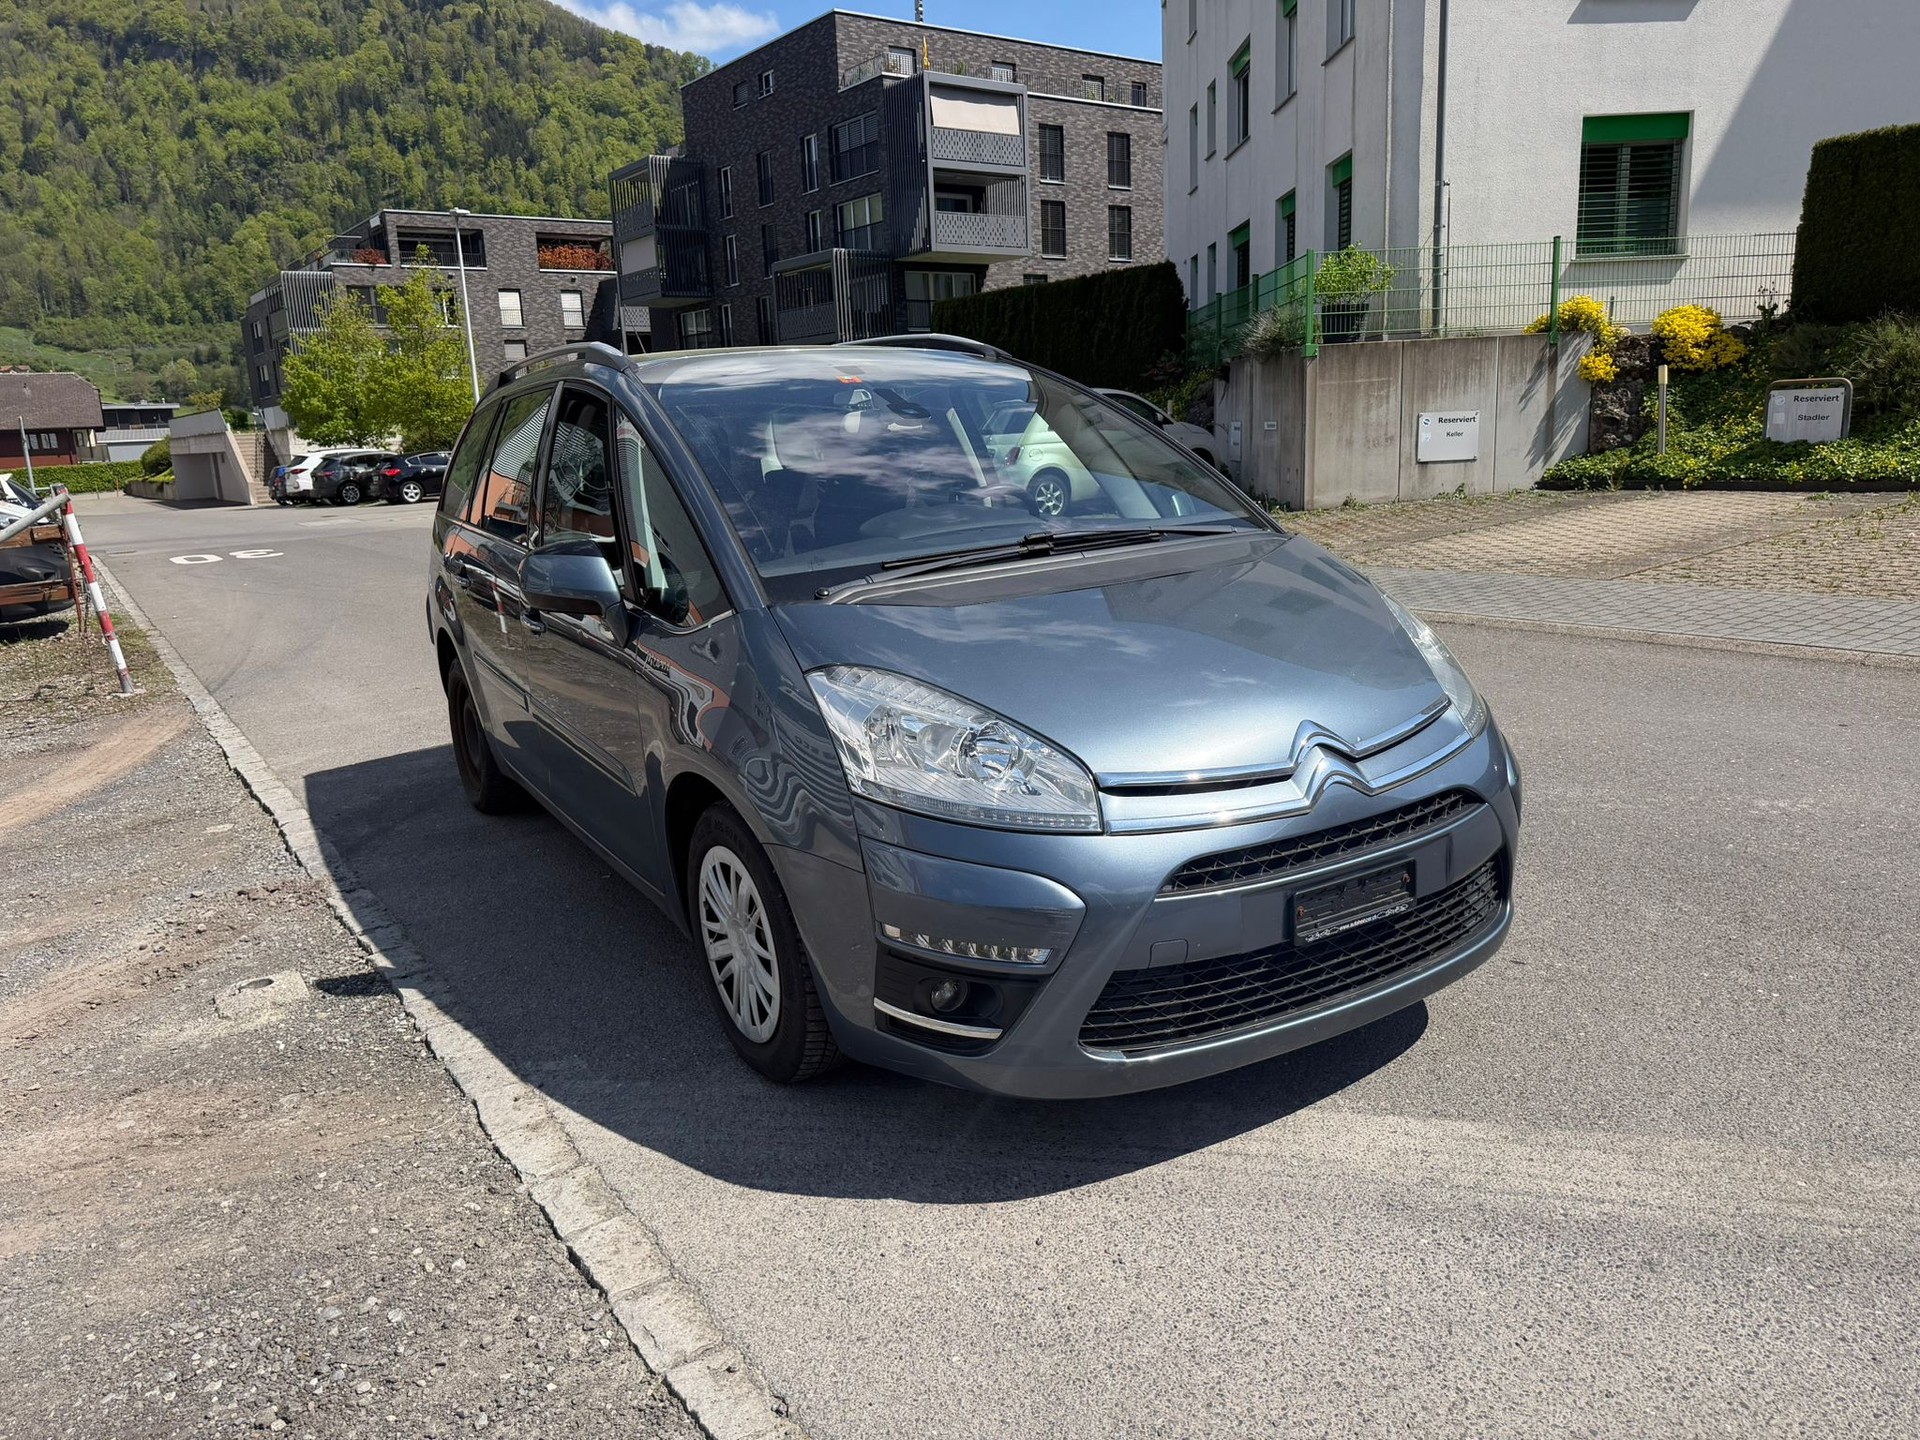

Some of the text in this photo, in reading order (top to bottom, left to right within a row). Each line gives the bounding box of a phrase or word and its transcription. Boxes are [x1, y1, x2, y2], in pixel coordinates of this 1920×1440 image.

[1793, 394, 1840, 403] Reserviert
[1438, 416, 1476, 424] Reserviert
[1797, 413, 1830, 421] Stadler
